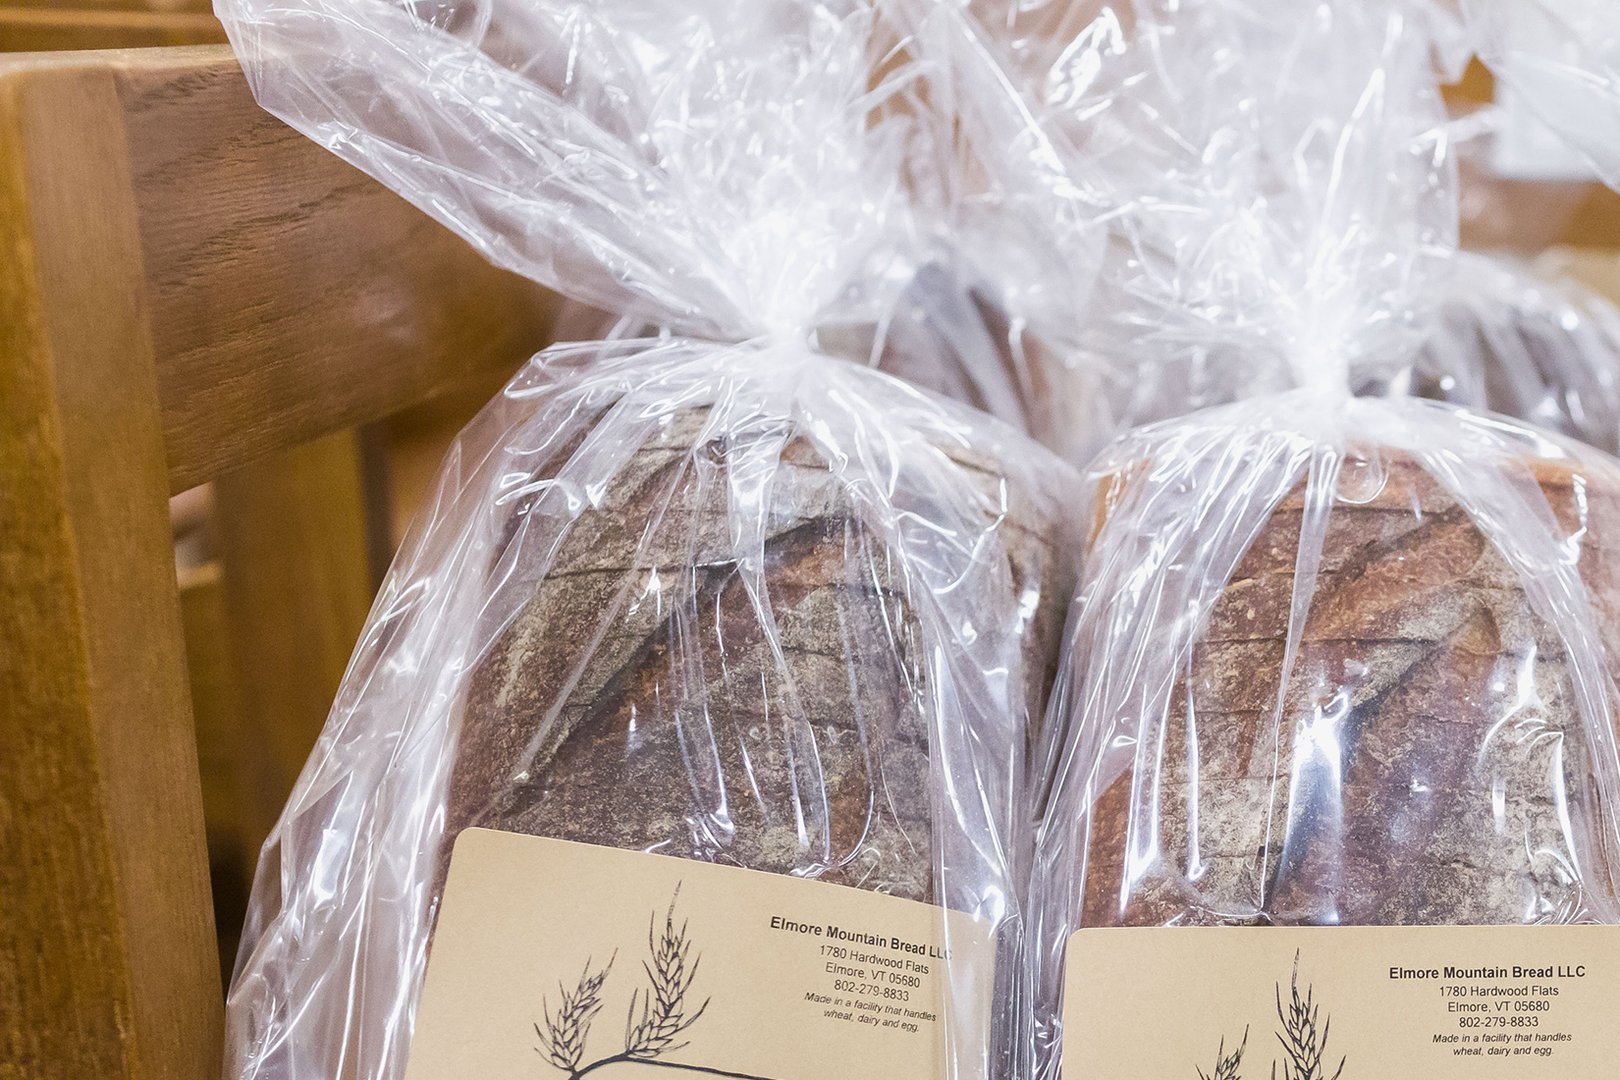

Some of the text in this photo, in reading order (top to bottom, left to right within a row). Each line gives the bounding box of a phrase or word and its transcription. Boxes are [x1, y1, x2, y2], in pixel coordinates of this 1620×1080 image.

[771, 916, 822, 936] Elmore
[827, 926, 886, 947] Mountain
[891, 938, 926, 955] Bread
[821, 945, 929, 974] 1780 Hardwood Flats
[826, 962, 920, 988] Elmore, VT 05680
[1390, 966, 1585, 979] Elmore Mountain Bread LLC
[834, 979, 909, 1001] 802-279-8833
[1440, 985, 1559, 997] 1780 Hardwood Flats
[1448, 1001, 1549, 1012] Elmore, VT 05680
[1459, 1016, 1538, 1028] 802-279-8833
